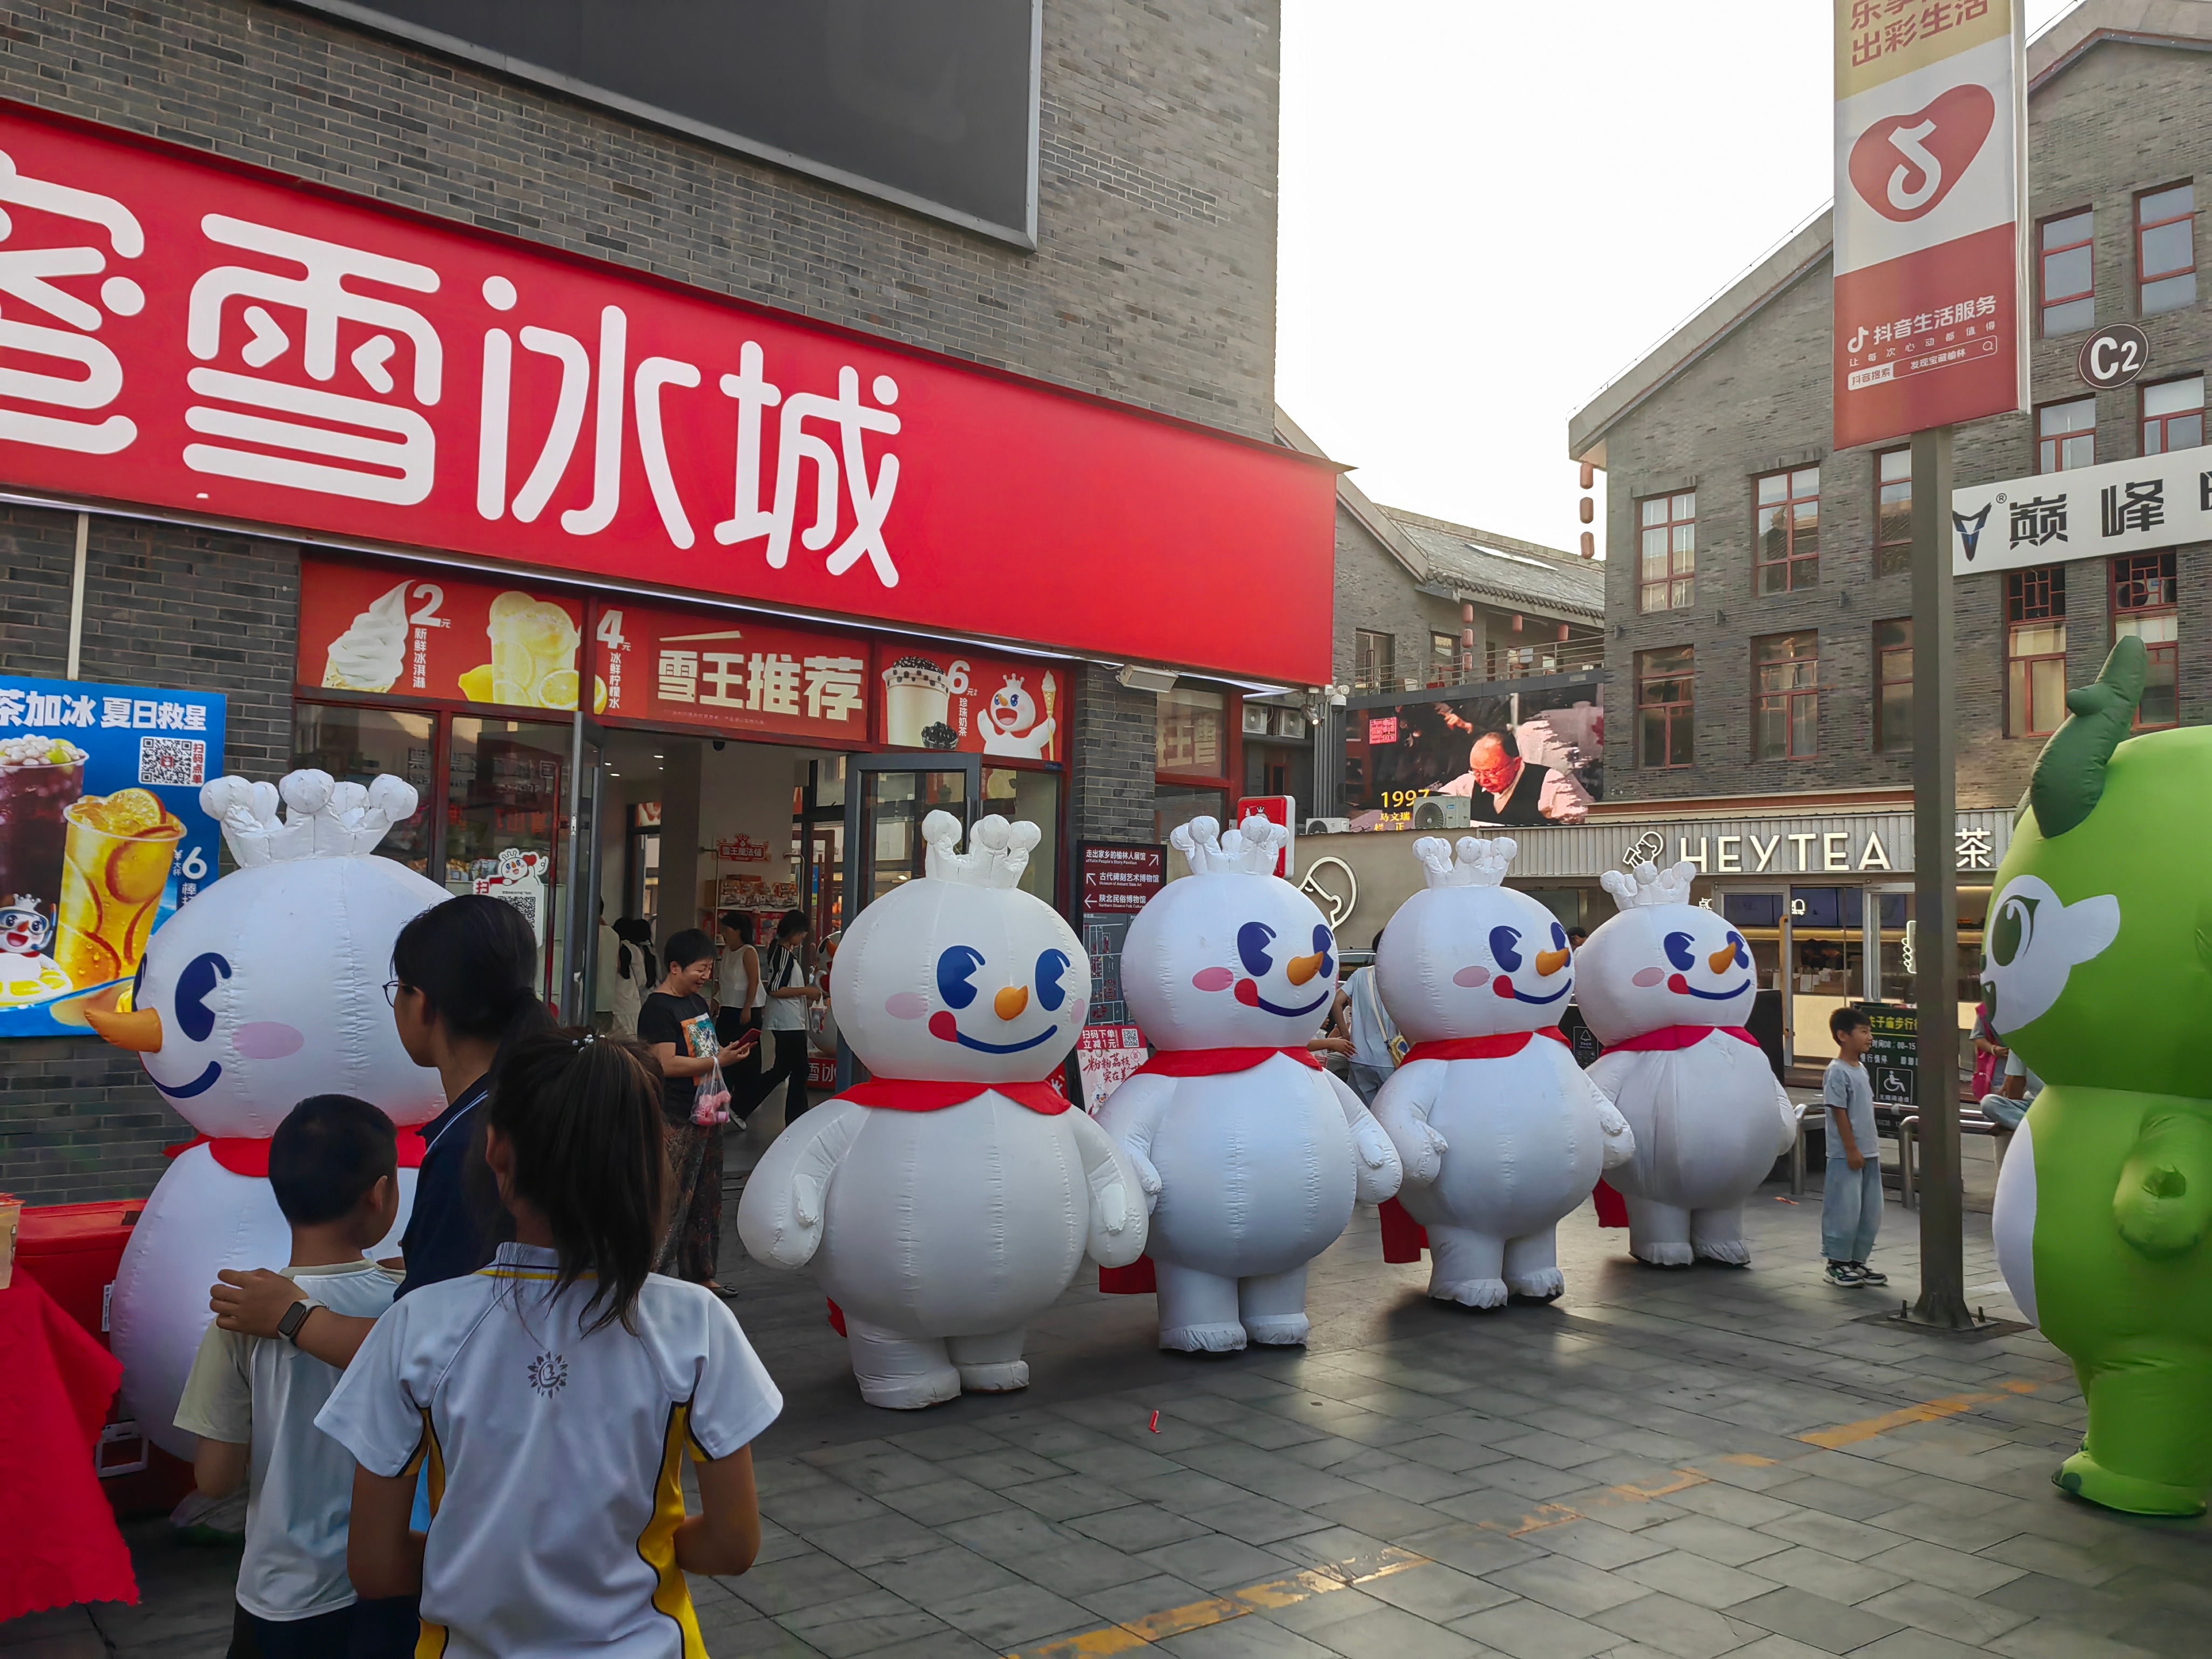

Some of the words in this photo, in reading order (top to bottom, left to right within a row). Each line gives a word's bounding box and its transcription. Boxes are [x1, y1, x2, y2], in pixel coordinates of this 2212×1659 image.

[1873, 295, 1997, 345] 抖音生活服务
[1852, 367, 1891, 386] 抖音搜索
[2090, 337, 2140, 380] C2
[2009, 471, 2212, 551] 巅峰
[413, 628, 427, 689] 新鲜冰淇淋
[608, 652, 621, 709] 冰鲜柠檬水
[657, 650, 864, 721] 雪王推荐
[100, 696, 207, 731] 夏日救星
[958, 697, 968, 737] 珍珠奶茶
[1379, 811, 1410, 822] 马文瑞
[1086, 849, 1146, 861] 走出家乡的榆林人展馆
[1680, 832, 1891, 873] HEYTEA
[1955, 827, 1993, 869] 茶
[1100, 872, 1159, 883] 古代碑刻艺术博物馆
[1098, 894, 1146, 904] 陕北民俗博物馆
[1082, 1029, 1115, 1039] 扫码下单
[1083, 1040, 1116, 1049] 立减1元
